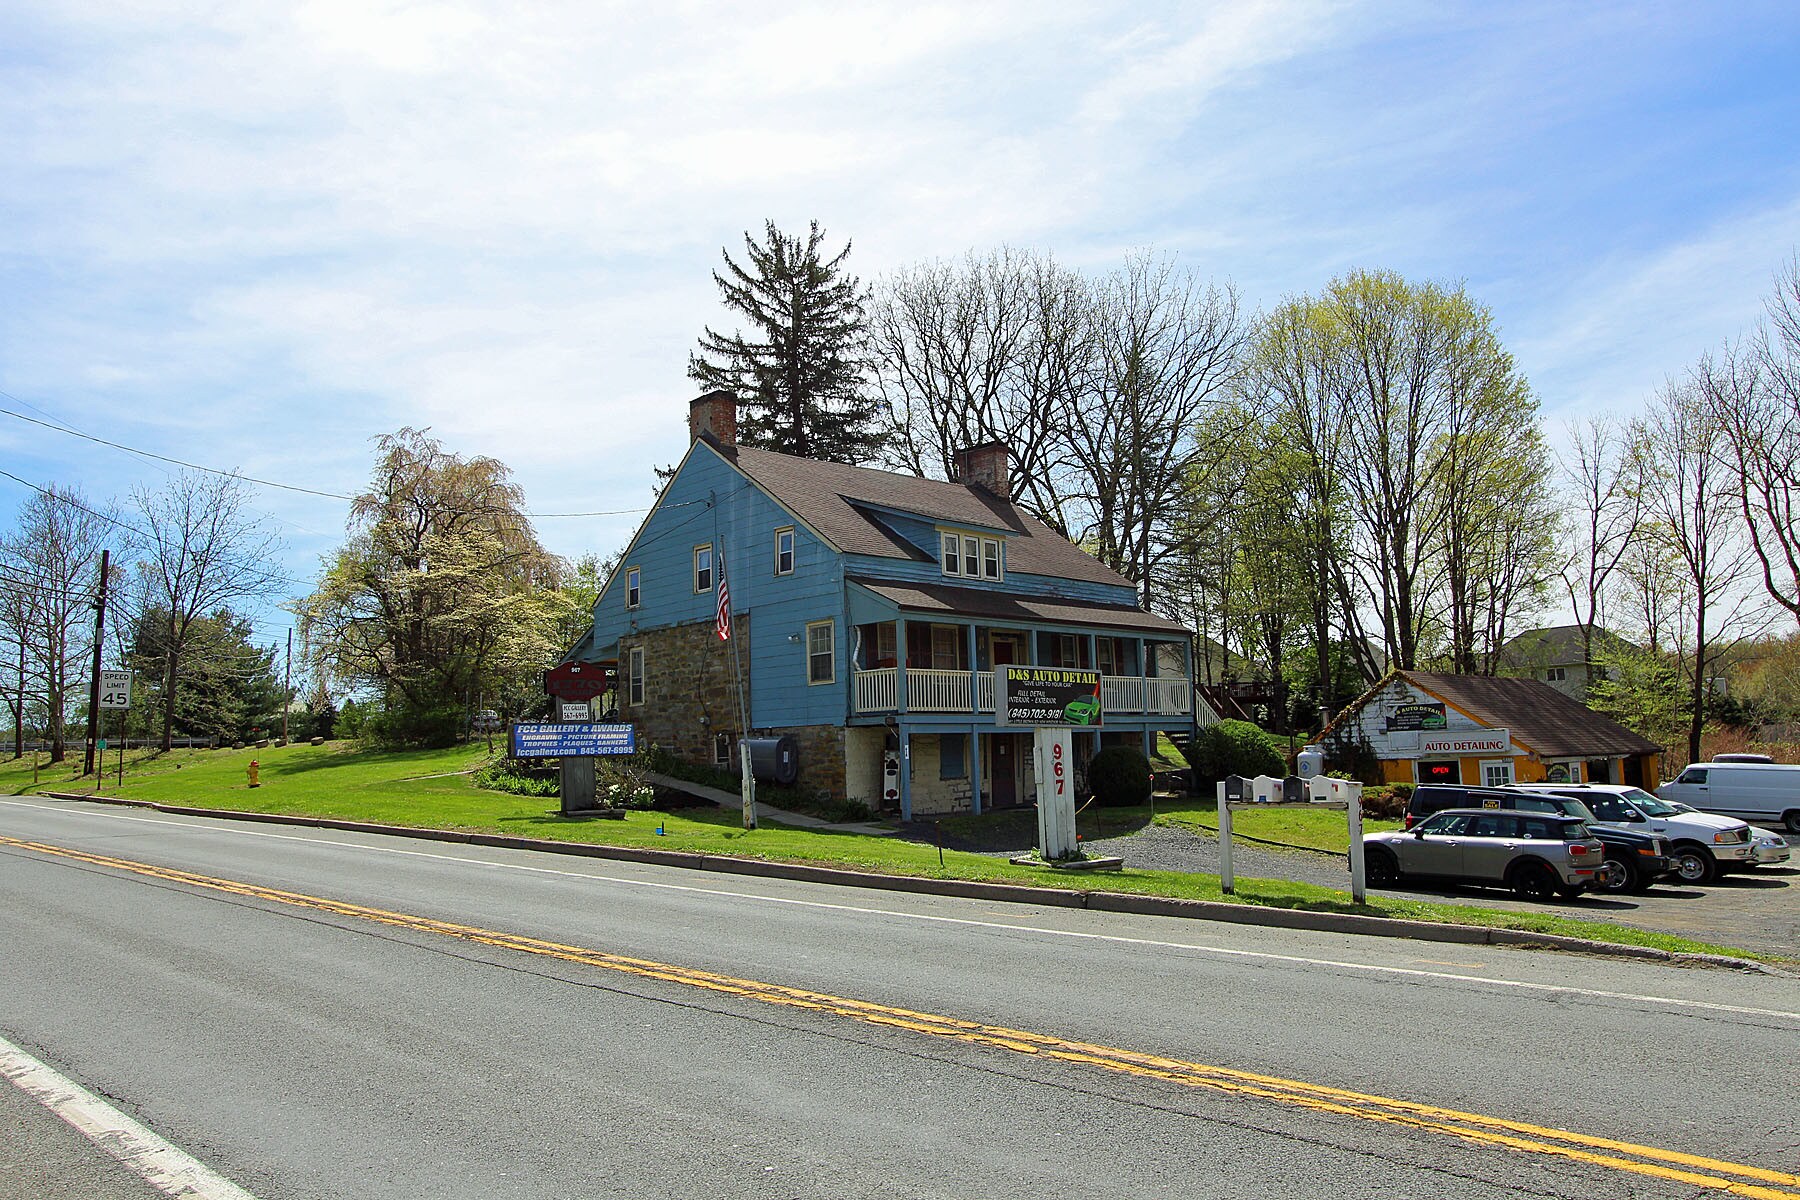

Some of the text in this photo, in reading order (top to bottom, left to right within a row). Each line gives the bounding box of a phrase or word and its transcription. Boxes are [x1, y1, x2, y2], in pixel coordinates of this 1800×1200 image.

[1007, 668, 1097, 685] D&S AUTO DETAIL
[102, 692, 127, 705] 45
[1029, 690, 1046, 698] DETAIL
[1034, 697, 1057, 705] EXTERIOR
[563, 711, 588, 719] 567-6995
[1419, 706, 1442, 716] DETAIL
[517, 725, 538, 733] FCC
[539, 724, 581, 733] GALLERY
[591, 724, 632, 732] AWARDS
[1425, 740, 1504, 751] AUTO DETAILING
[516, 746, 633, 757] fccgallery.com 845-567-6995
[1053, 743, 1064, 795] 967
[1432, 766, 1449, 774] OPEN
